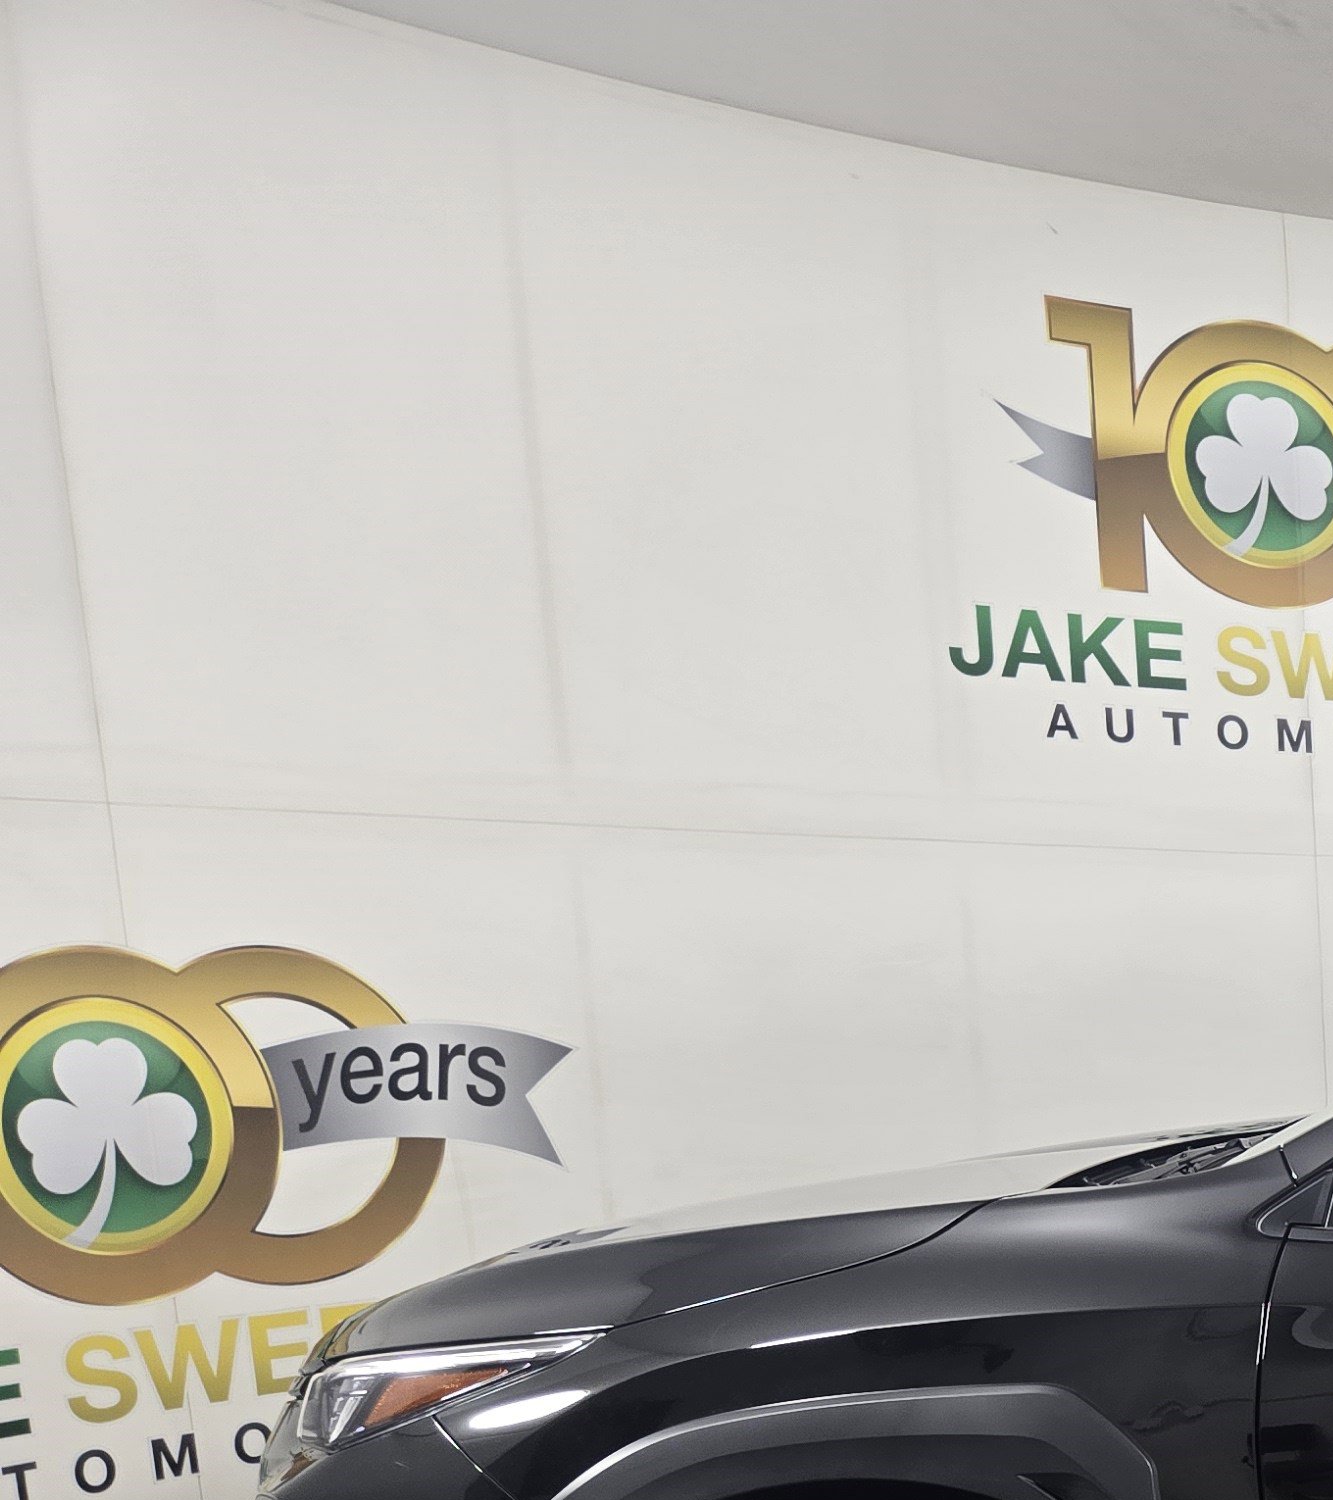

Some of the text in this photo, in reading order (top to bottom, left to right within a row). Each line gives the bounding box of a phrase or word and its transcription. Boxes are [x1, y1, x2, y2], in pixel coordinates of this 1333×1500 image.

[949, 605, 1188, 692] JAKE
[291, 1039, 507, 1132] years
[65, 1303, 371, 1424] SWE
